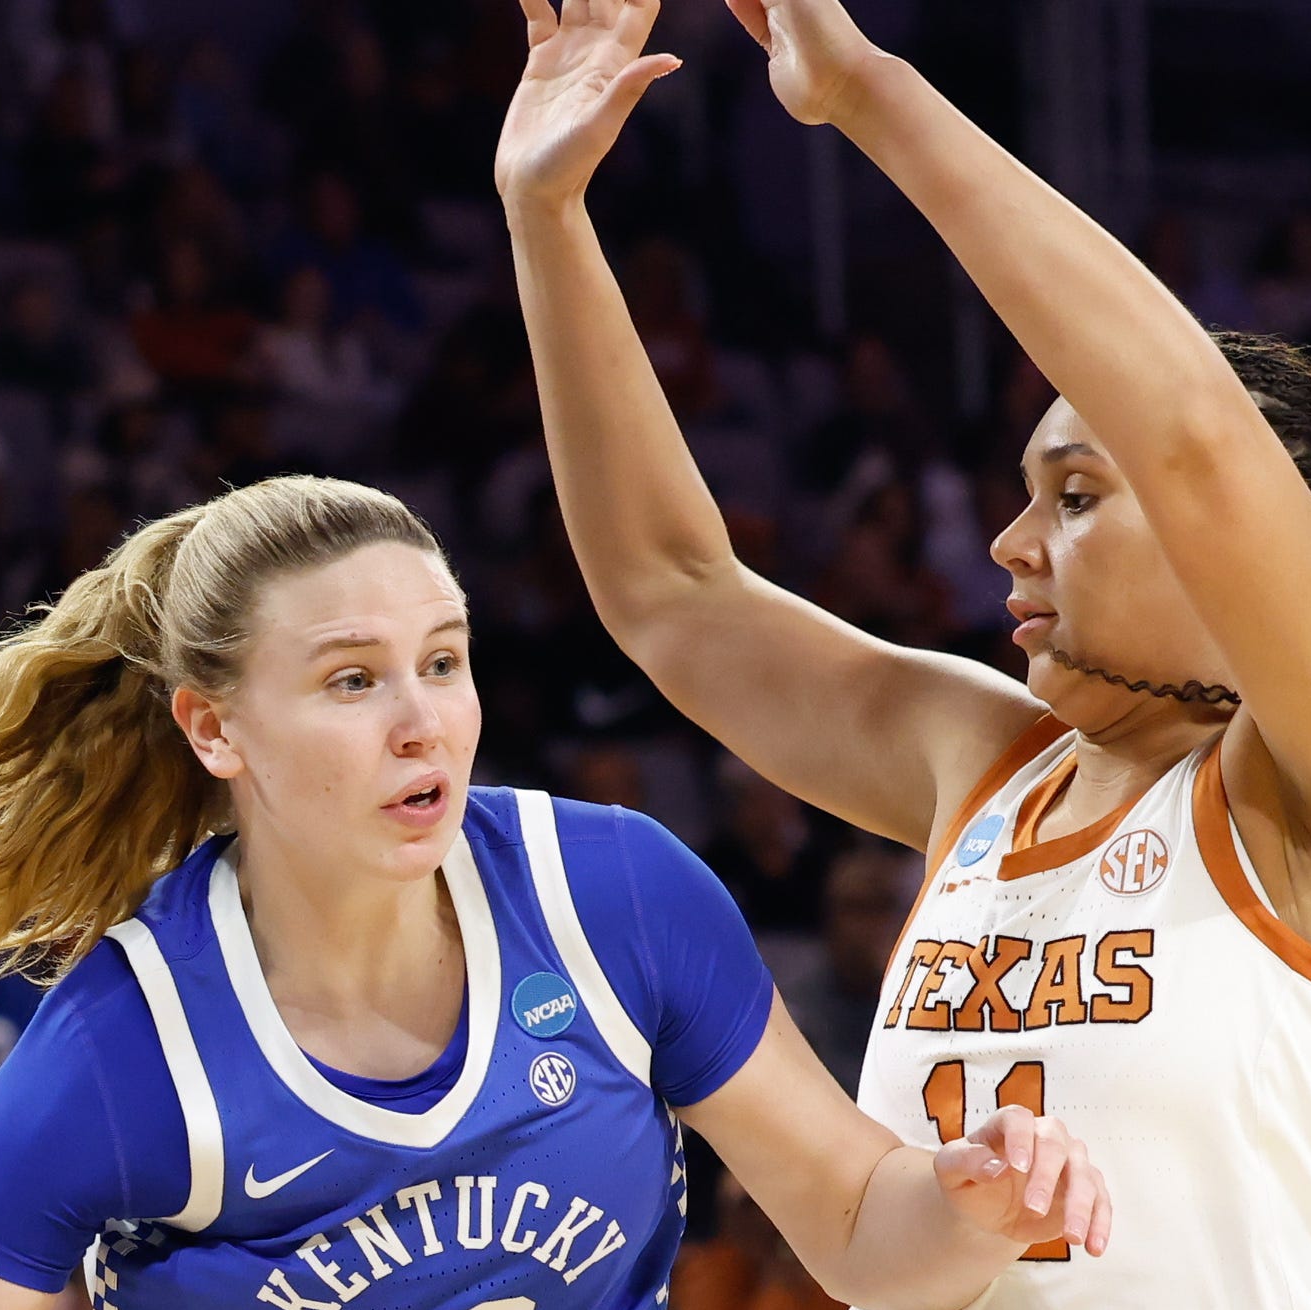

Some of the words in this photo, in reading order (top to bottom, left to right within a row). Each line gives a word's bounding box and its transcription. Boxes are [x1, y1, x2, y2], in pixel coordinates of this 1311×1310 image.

[1101, 830, 1168, 892] SEC
[884, 929, 1155, 1031] TEXAS
[523, 993, 575, 1028] NCAA
[532, 1056, 573, 1104] SEC
